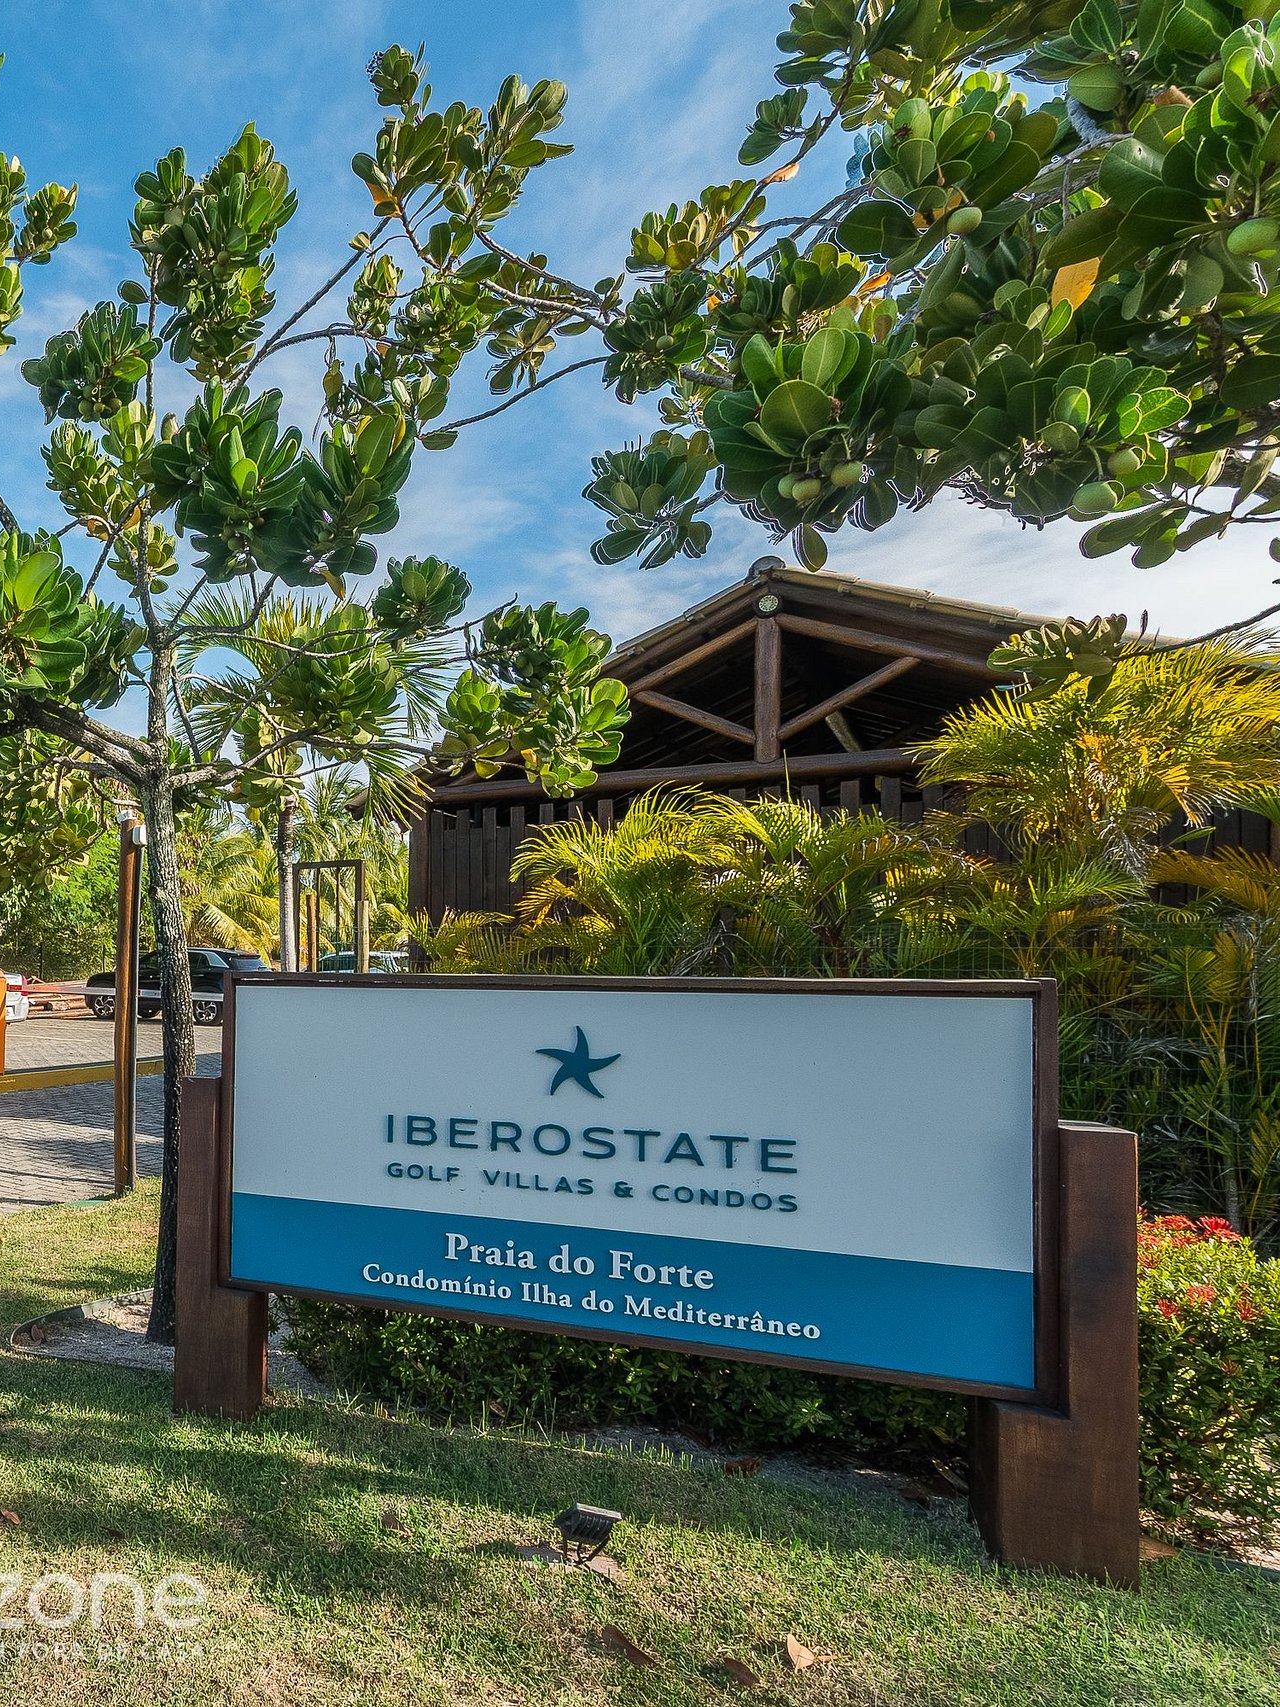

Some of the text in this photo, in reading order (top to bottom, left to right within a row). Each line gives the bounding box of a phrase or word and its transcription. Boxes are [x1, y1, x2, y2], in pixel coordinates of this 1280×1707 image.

[387, 1114, 798, 1174] IBEROSTATE
[387, 1162, 798, 1212] GOLF VILLAS & CONDOS
[444, 1232, 714, 1290] Praia do Forte
[362, 1263, 820, 1339] Condomínio Ilha do Mediterrâneo
